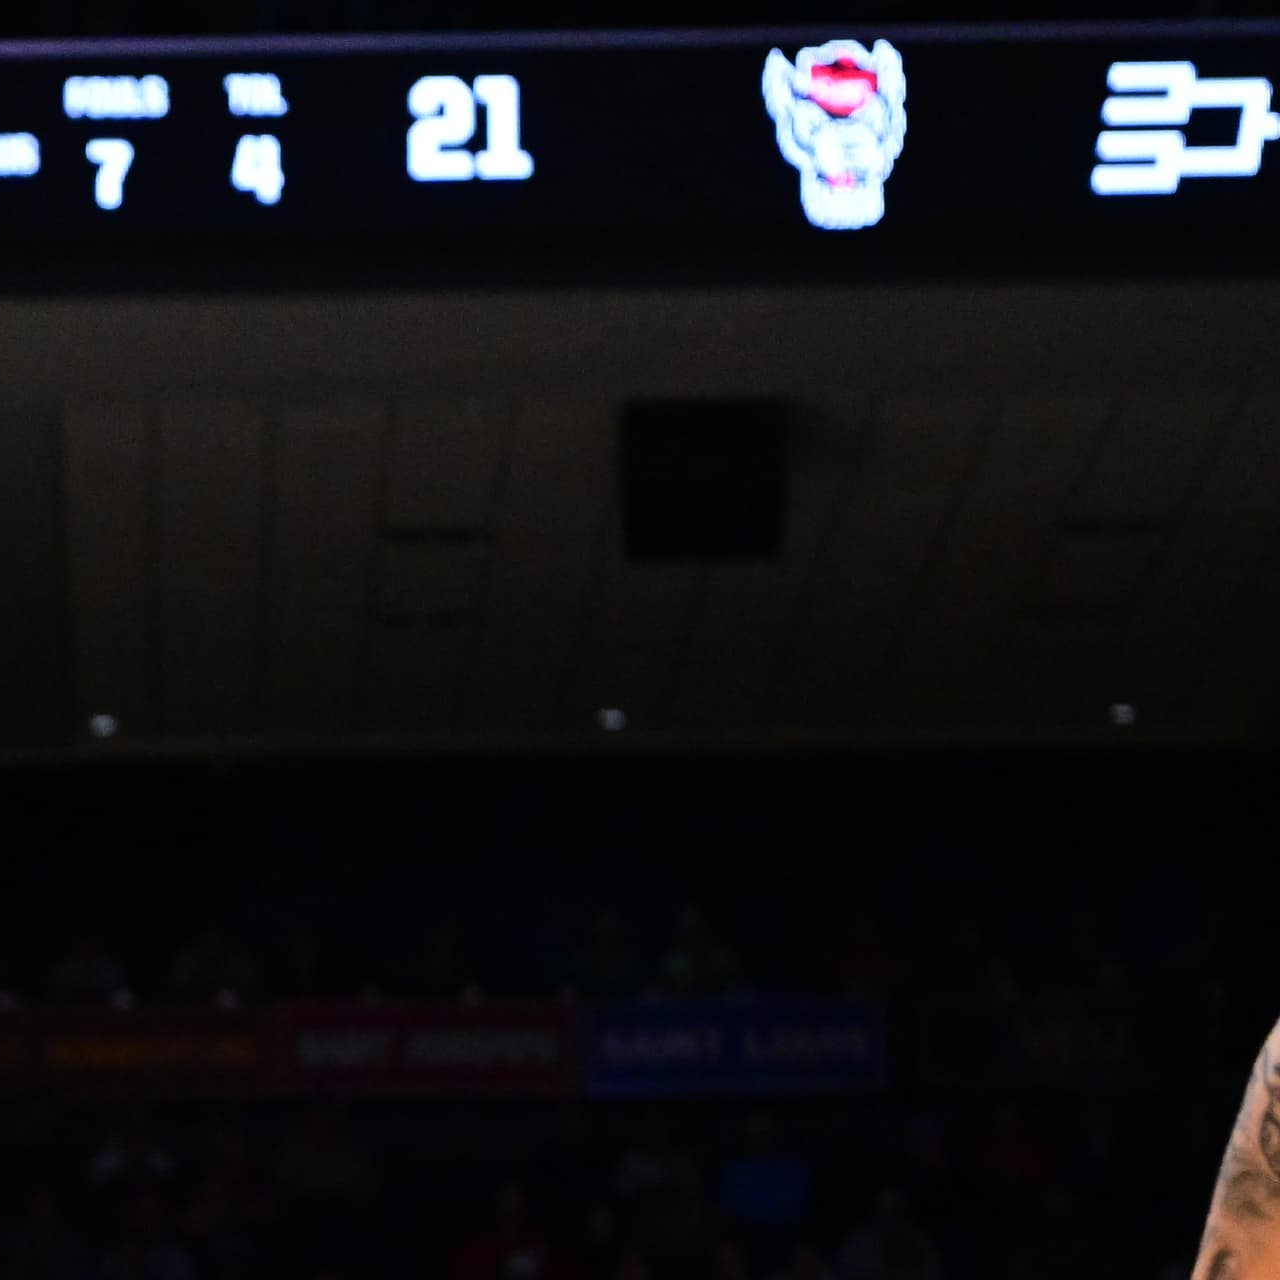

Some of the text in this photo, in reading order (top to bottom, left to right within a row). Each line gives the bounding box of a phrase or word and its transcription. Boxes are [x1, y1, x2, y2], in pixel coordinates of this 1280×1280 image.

[406, 74, 534, 182] 21
[85, 138, 135, 210] 7
[231, 134, 285, 205] 4
